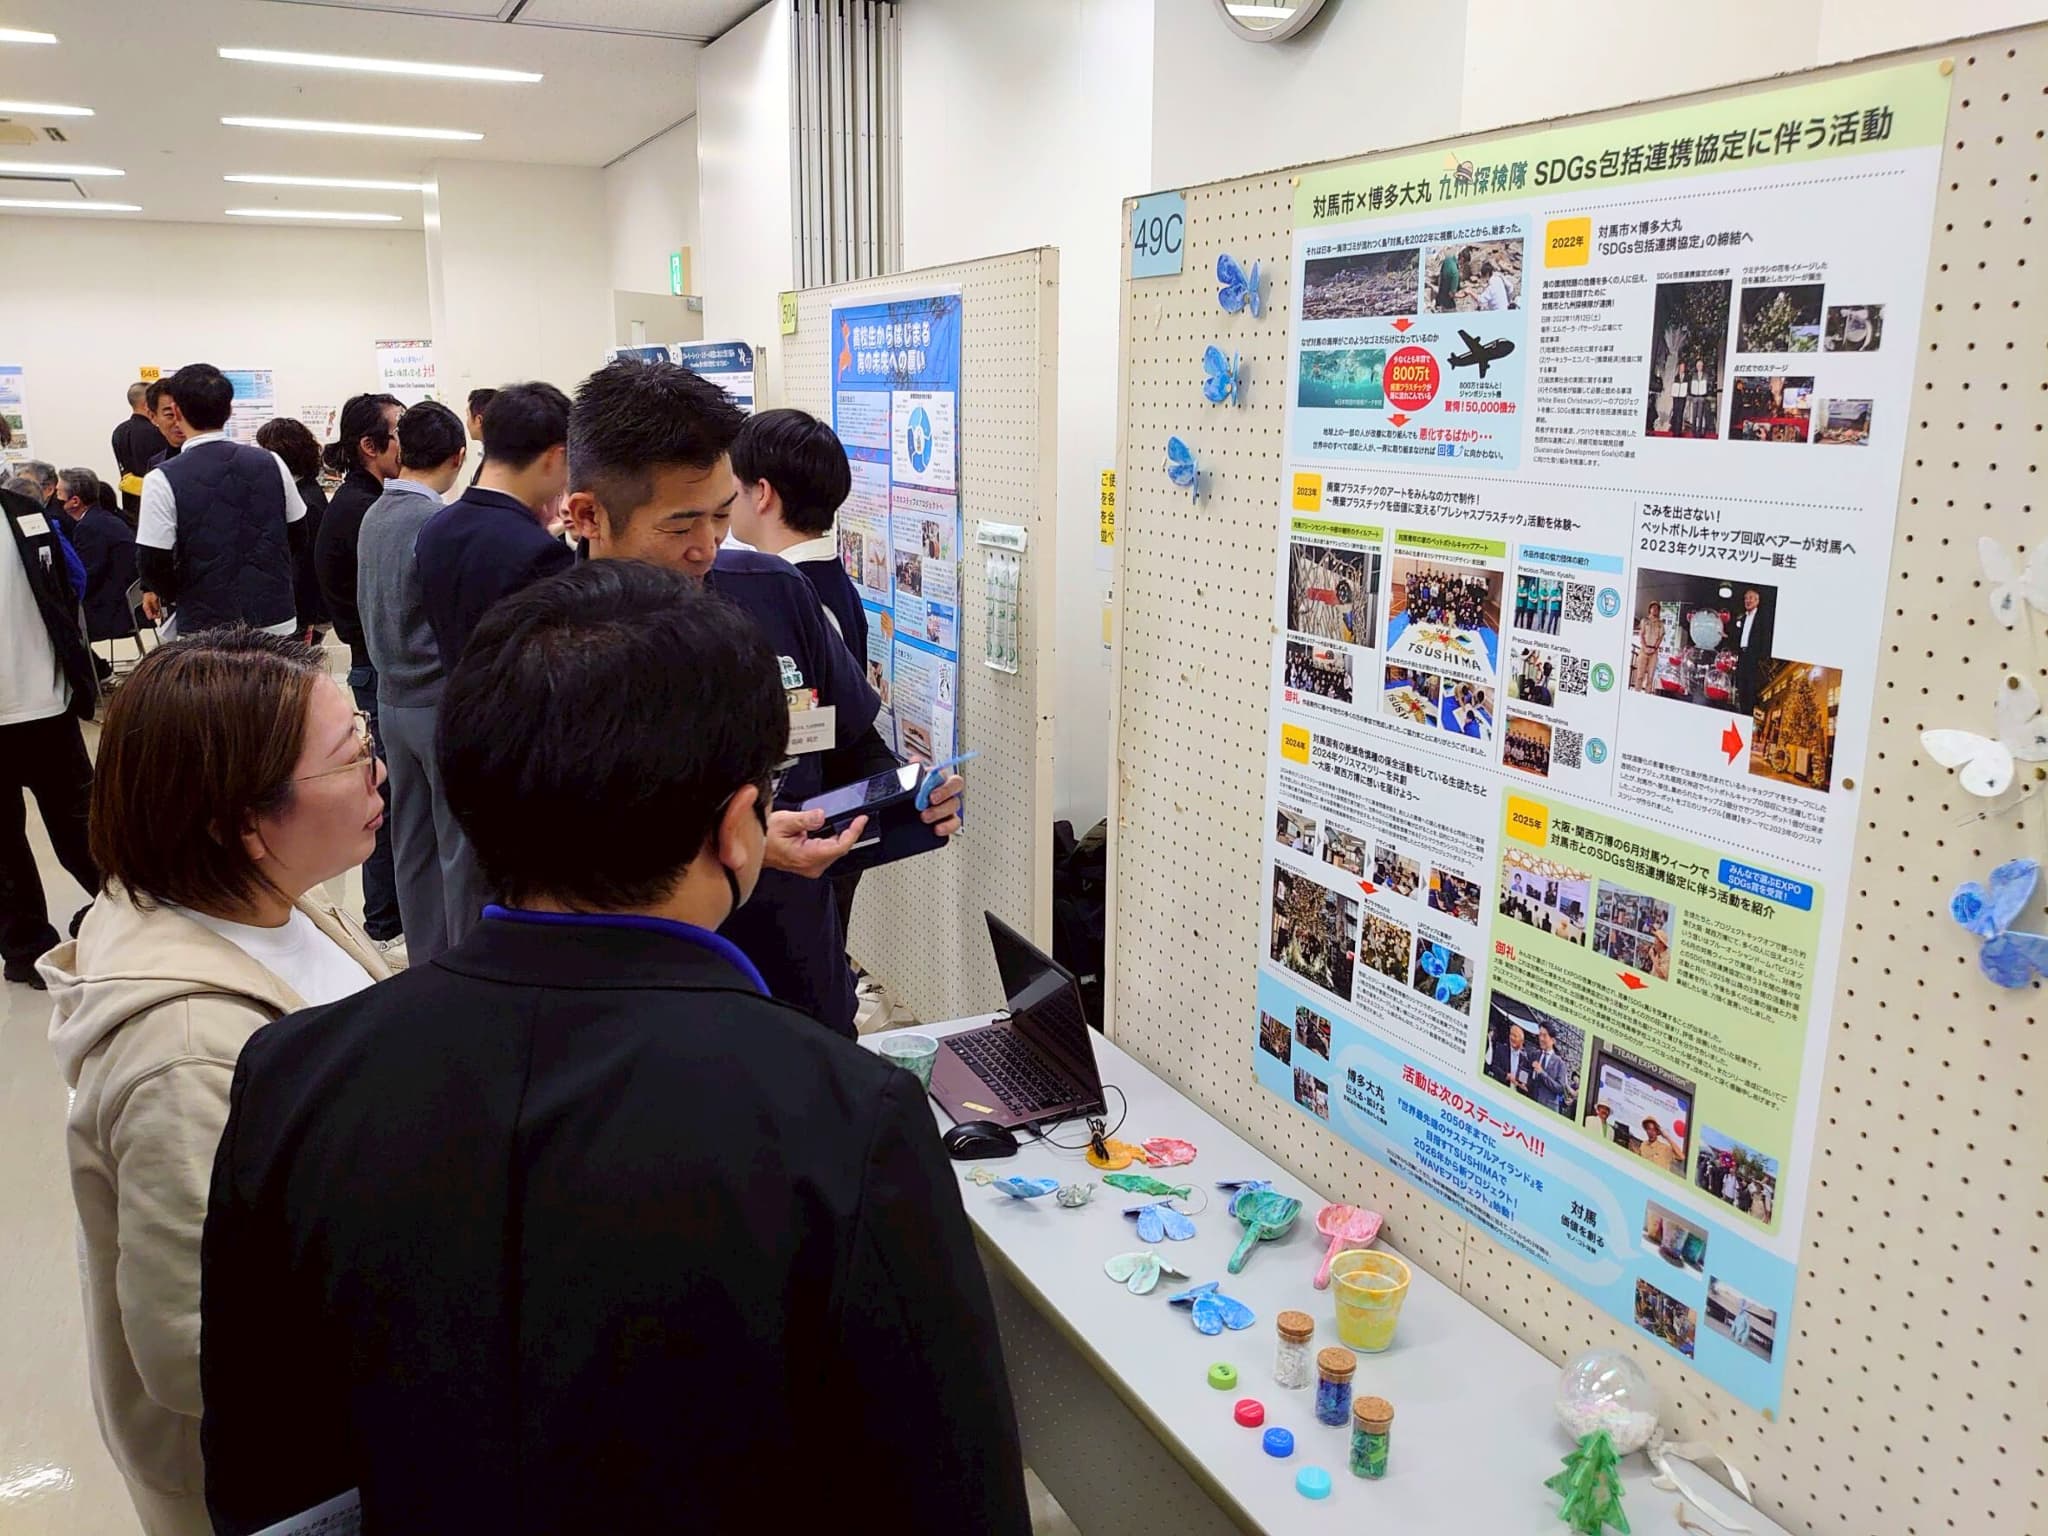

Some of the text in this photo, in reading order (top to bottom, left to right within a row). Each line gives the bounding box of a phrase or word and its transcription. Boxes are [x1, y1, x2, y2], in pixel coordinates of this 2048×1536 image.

[1312, 176, 1433, 219] 対馬市×博多大丸
[1535, 106, 1894, 187] SDGs包括連携協定に伴う活動
[1134, 213, 1183, 257] 49C
[1551, 234, 1585, 249] 2022年
[1596, 227, 1755, 258] 「SDGs包括連携協定」の締結へ
[1597, 216, 1684, 240] 対馬市×博多大丸
[853, 321, 931, 350] 高校生からはじまる
[140, 368, 159, 379] 64B
[1392, 364, 1431, 381] 800万t
[1436, 443, 1455, 458] 回復
[1296, 486, 1317, 498] 2023年
[1639, 537, 1798, 569] 2023年クリスマスツリー誕生
[1408, 643, 1481, 671] TSUSHIMA
[1285, 736, 1305, 751] 2024年
[1311, 744, 1407, 786] 2024年クリスマスツリーを共創
[1511, 810, 1542, 831] 2025年
[1551, 817, 1710, 880] 大阪・関西万博の6月対馬ウィークで
[1549, 832, 1776, 921] 対馬市とのSDGs包括連携協定に伴う活動を紹介
[1728, 863, 1801, 897] みんなで選ぶEXPO
[1494, 939, 1516, 961] 御礼
[1346, 1065, 1385, 1102] 博多大丸
[1440, 1107, 1497, 1151] 2050年までに
[1425, 1128, 1507, 1188] 目指すTSUSHIMAで
[1570, 1198, 1597, 1229] 対馬
[1560, 1212, 1605, 1250] 価値を創る
